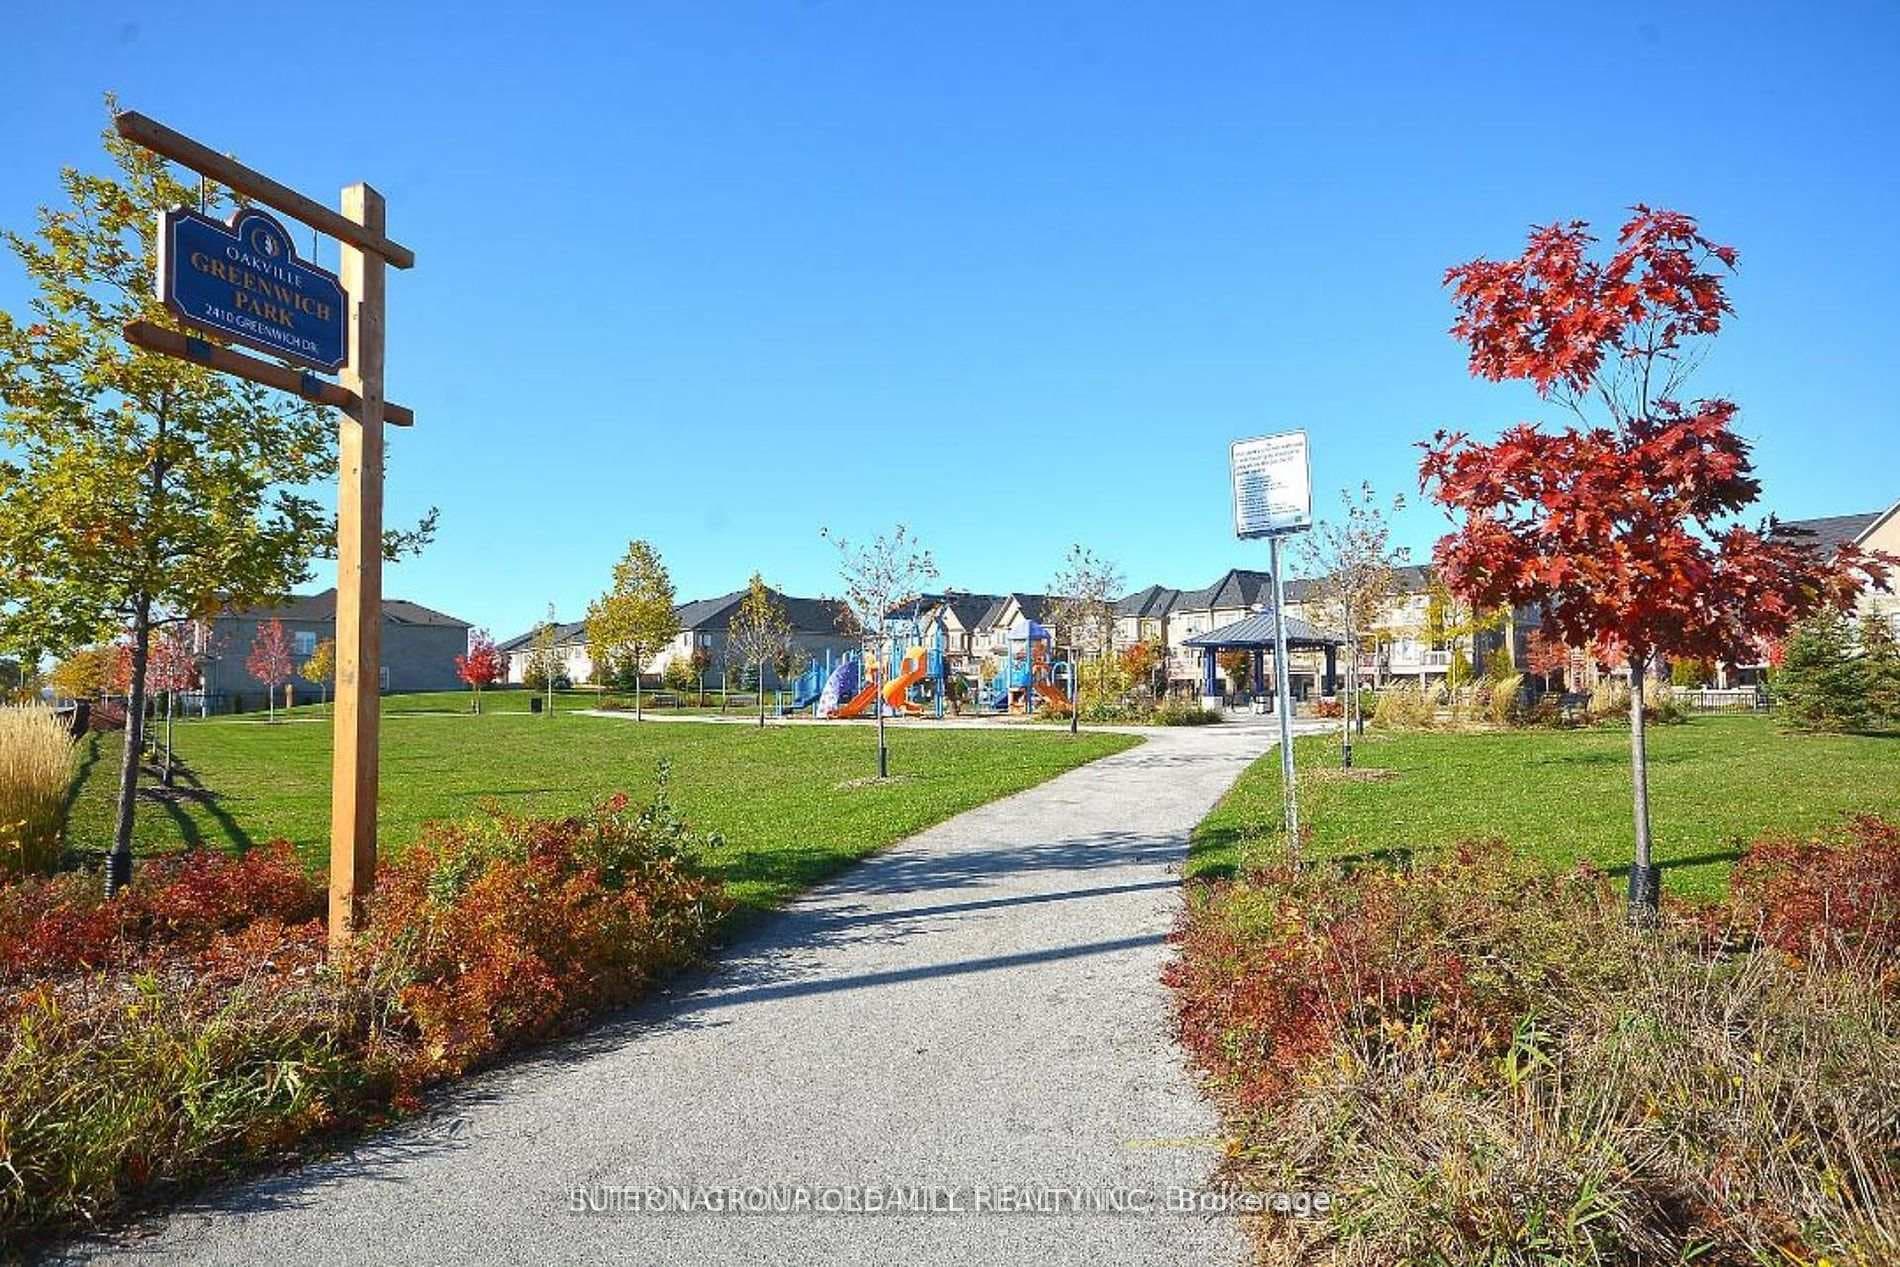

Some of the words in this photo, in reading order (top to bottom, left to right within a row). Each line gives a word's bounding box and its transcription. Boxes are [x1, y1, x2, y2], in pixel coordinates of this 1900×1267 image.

[191, 252, 331, 321] GREENWICH
[226, 247, 302, 287] OAKVILLE
[235, 290, 294, 328] PARK
[235, 315, 301, 347] GREENWICH
